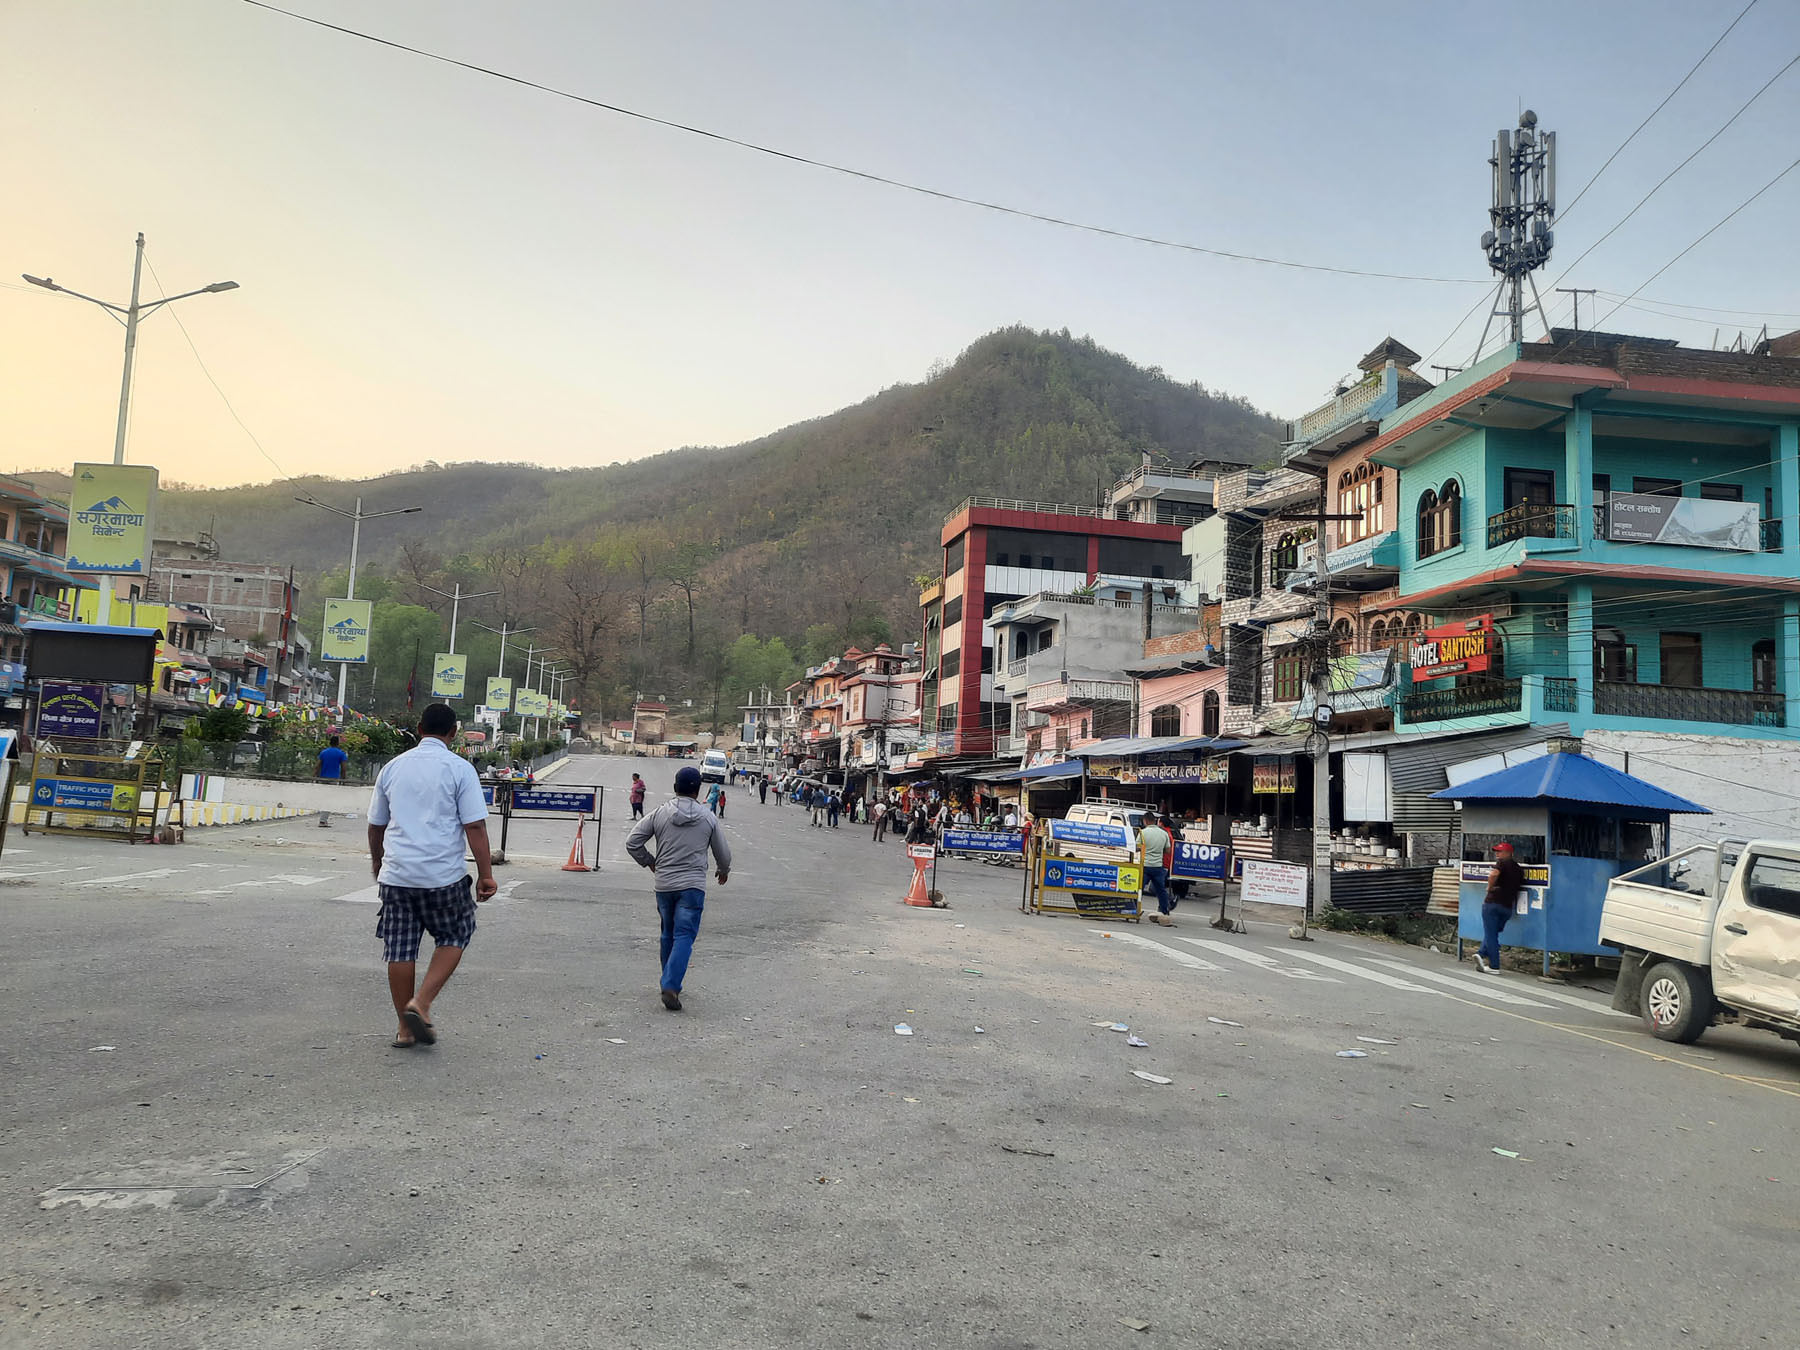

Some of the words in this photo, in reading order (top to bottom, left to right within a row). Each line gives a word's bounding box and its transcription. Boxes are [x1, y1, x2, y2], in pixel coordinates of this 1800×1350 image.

[1614, 502, 1635, 512] होटल
[1636, 505, 1661, 514] सन्तोष
[76, 511, 144, 526] सगरमाथा
[92, 525, 125, 536] सिमेन्ट
[1410, 642, 1439, 669] HOTEL
[1441, 631, 1485, 662] SANTOSH
[1159, 763, 1178, 779] होटल
[58, 784, 87, 793] TRAFFIC
[1182, 844, 1220, 861] STOP
[1067, 865, 1093, 874] TRAFFIC
[1094, 868, 1117, 876] POLICE
[1529, 869, 1548, 881] DRIVE
[1094, 880, 1109, 888] प्रहरी
